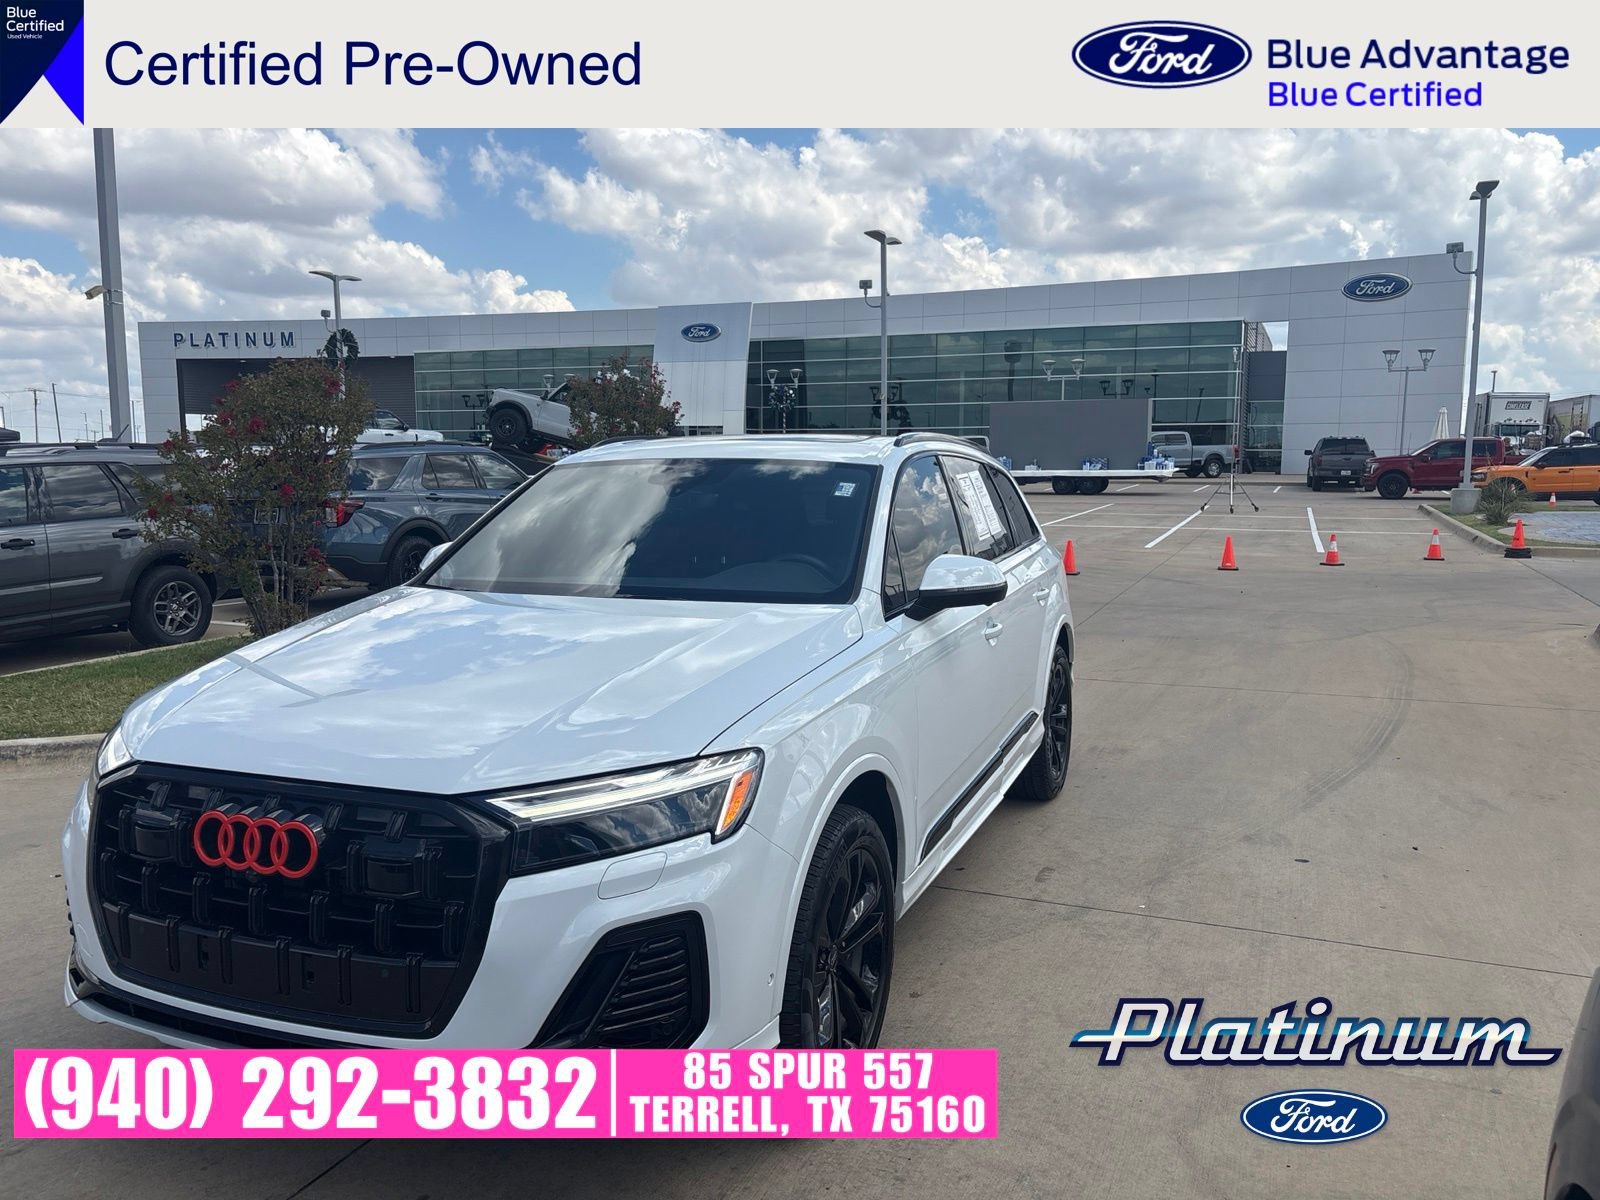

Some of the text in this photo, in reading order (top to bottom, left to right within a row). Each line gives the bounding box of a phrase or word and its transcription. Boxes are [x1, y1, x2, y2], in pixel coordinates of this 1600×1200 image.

[1355, 279, 1396, 295] Ford
[173, 331, 296, 348] PLATINUM
[688, 326, 711, 337] Ford
